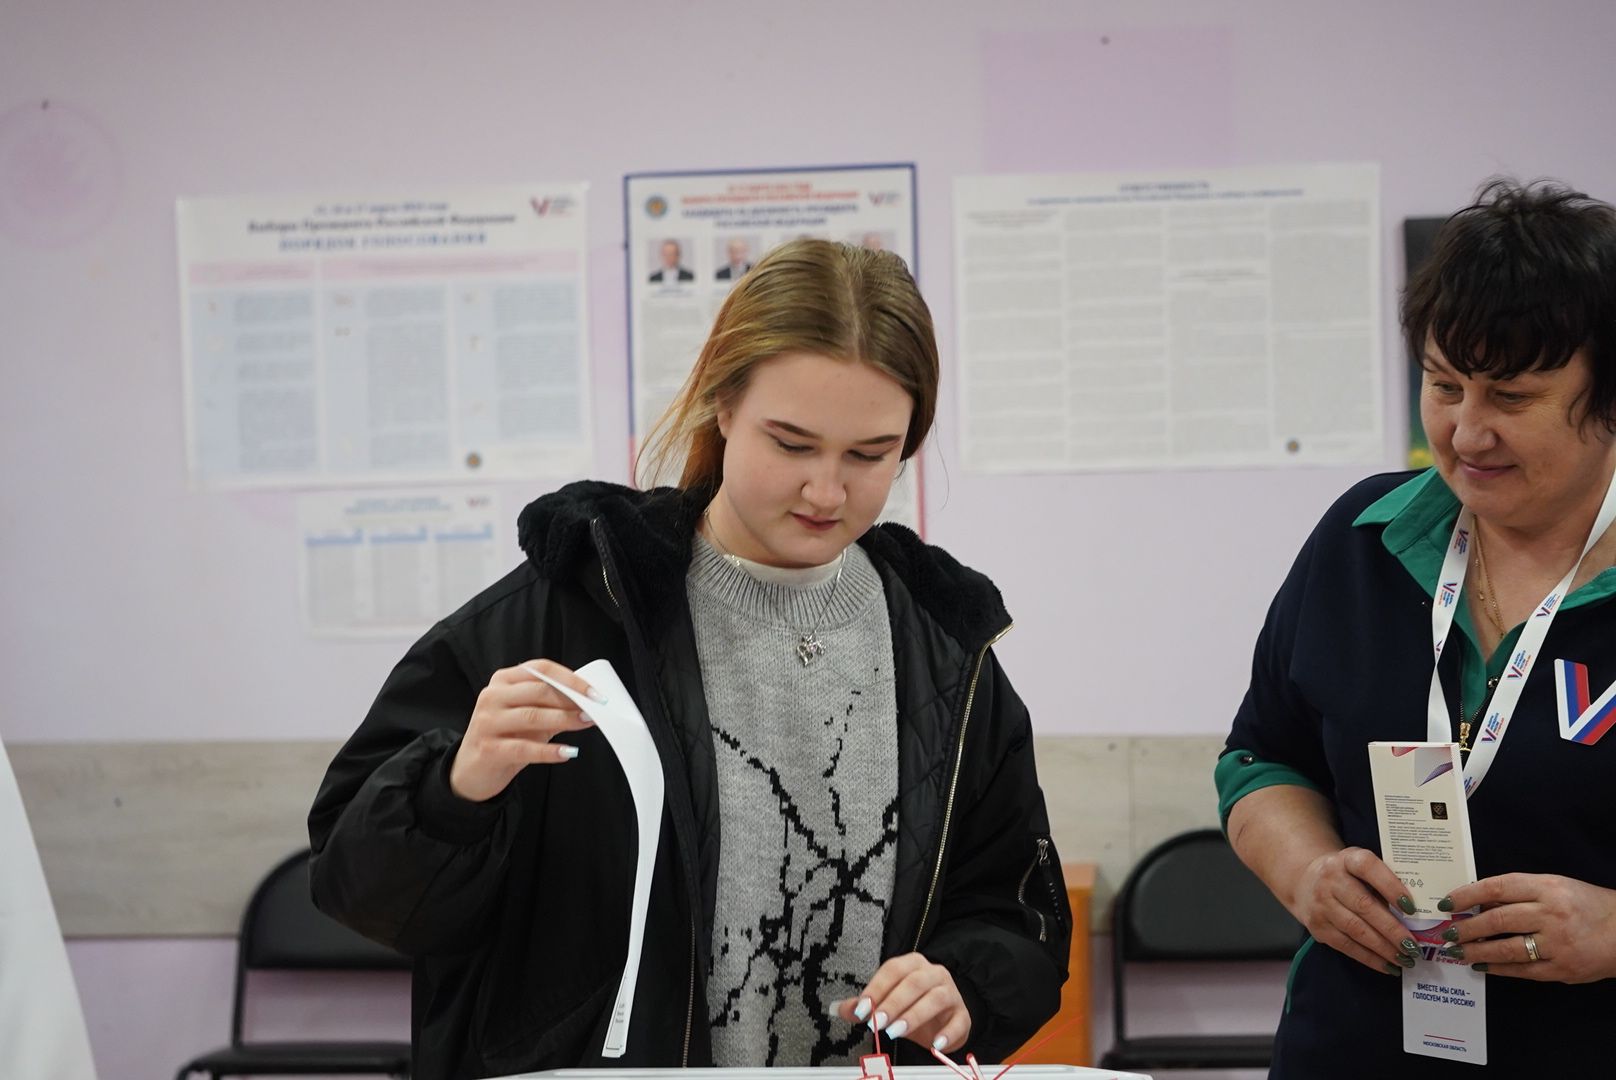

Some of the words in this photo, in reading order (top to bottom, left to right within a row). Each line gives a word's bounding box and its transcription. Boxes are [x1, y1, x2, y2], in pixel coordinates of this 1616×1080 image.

[1417, 983, 1438, 992] ВМЕСТЕ
[1439, 986, 1449, 994] МЫ
[1450, 988, 1465, 996] СИЛА
[1413, 992, 1441, 1002] ГОЛОСУЕМ
[1442, 996, 1449, 1004] ЗА
[1450, 997, 1475, 1007] РОССИЮ!
